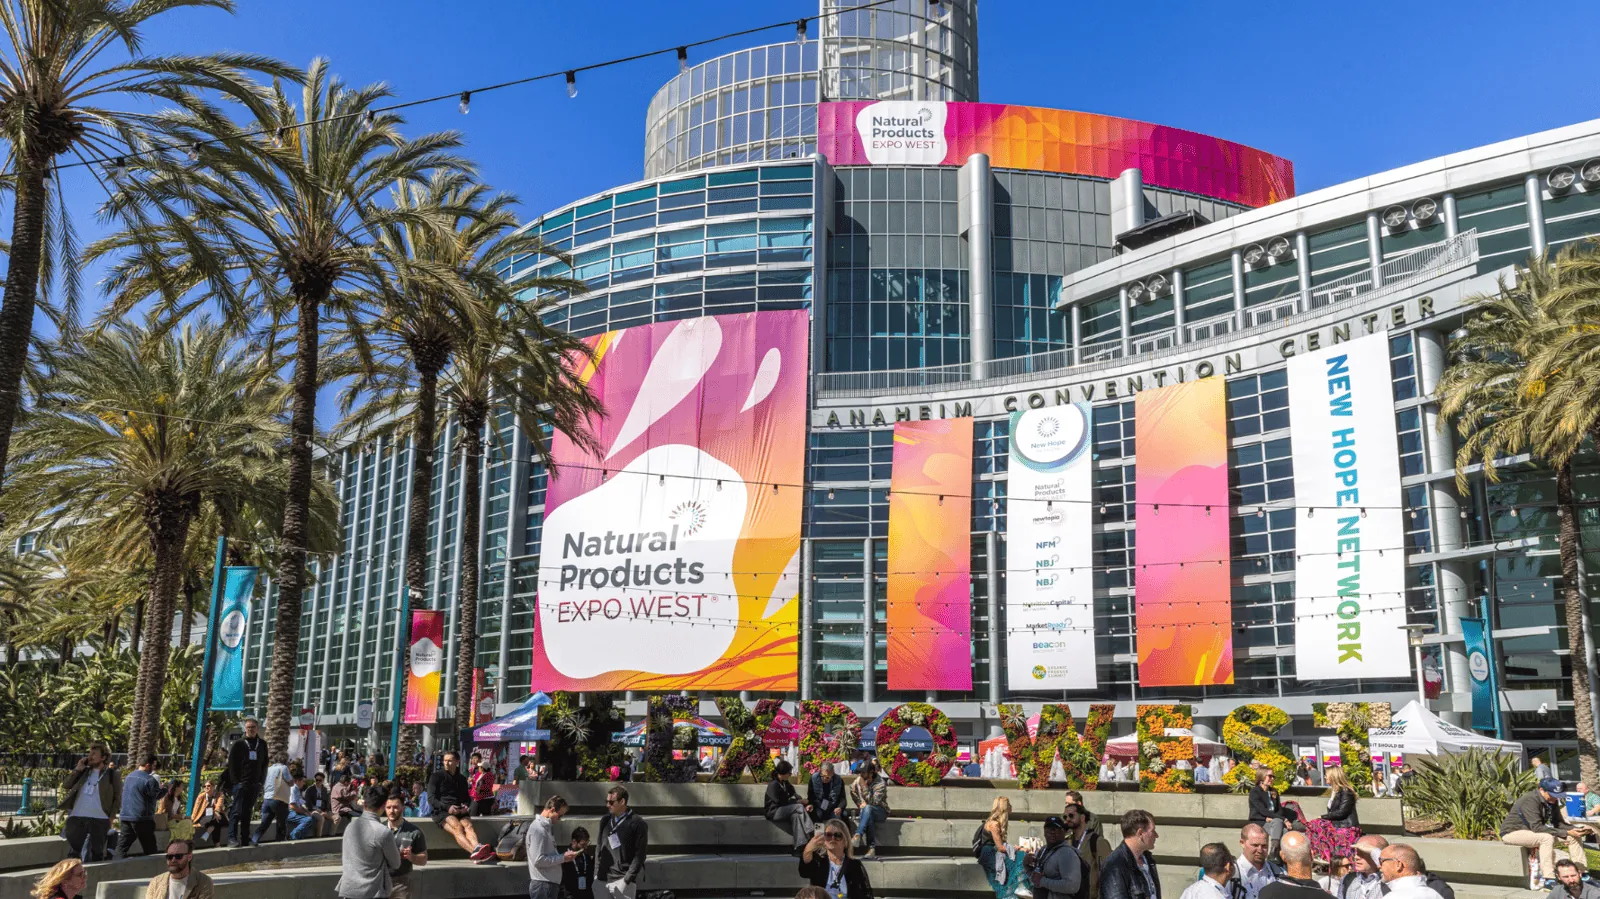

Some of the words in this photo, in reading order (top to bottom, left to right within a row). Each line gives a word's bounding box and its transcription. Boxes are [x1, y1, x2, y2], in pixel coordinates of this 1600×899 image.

[872, 116, 922, 126] Natural
[872, 128, 934, 138] Products
[872, 141, 903, 149] EXPO
[905, 141, 936, 149] WEST
[826, 401, 972, 429] ANAHEIM
[1003, 352, 1243, 411] CONVENTION
[1279, 296, 1435, 357] CENTER
[1326, 354, 1353, 417] NEW
[1331, 427, 1359, 507] HOPE
[1034, 488, 1066, 497] Products
[563, 524, 679, 559] Natural
[1036, 541, 1056, 549] NFM
[1036, 560, 1054, 568] NBJ
[560, 557, 705, 592] Products
[1036, 578, 1054, 586] NBJ
[1337, 515, 1363, 664] NETWORK
[558, 598, 622, 623] EXPO
